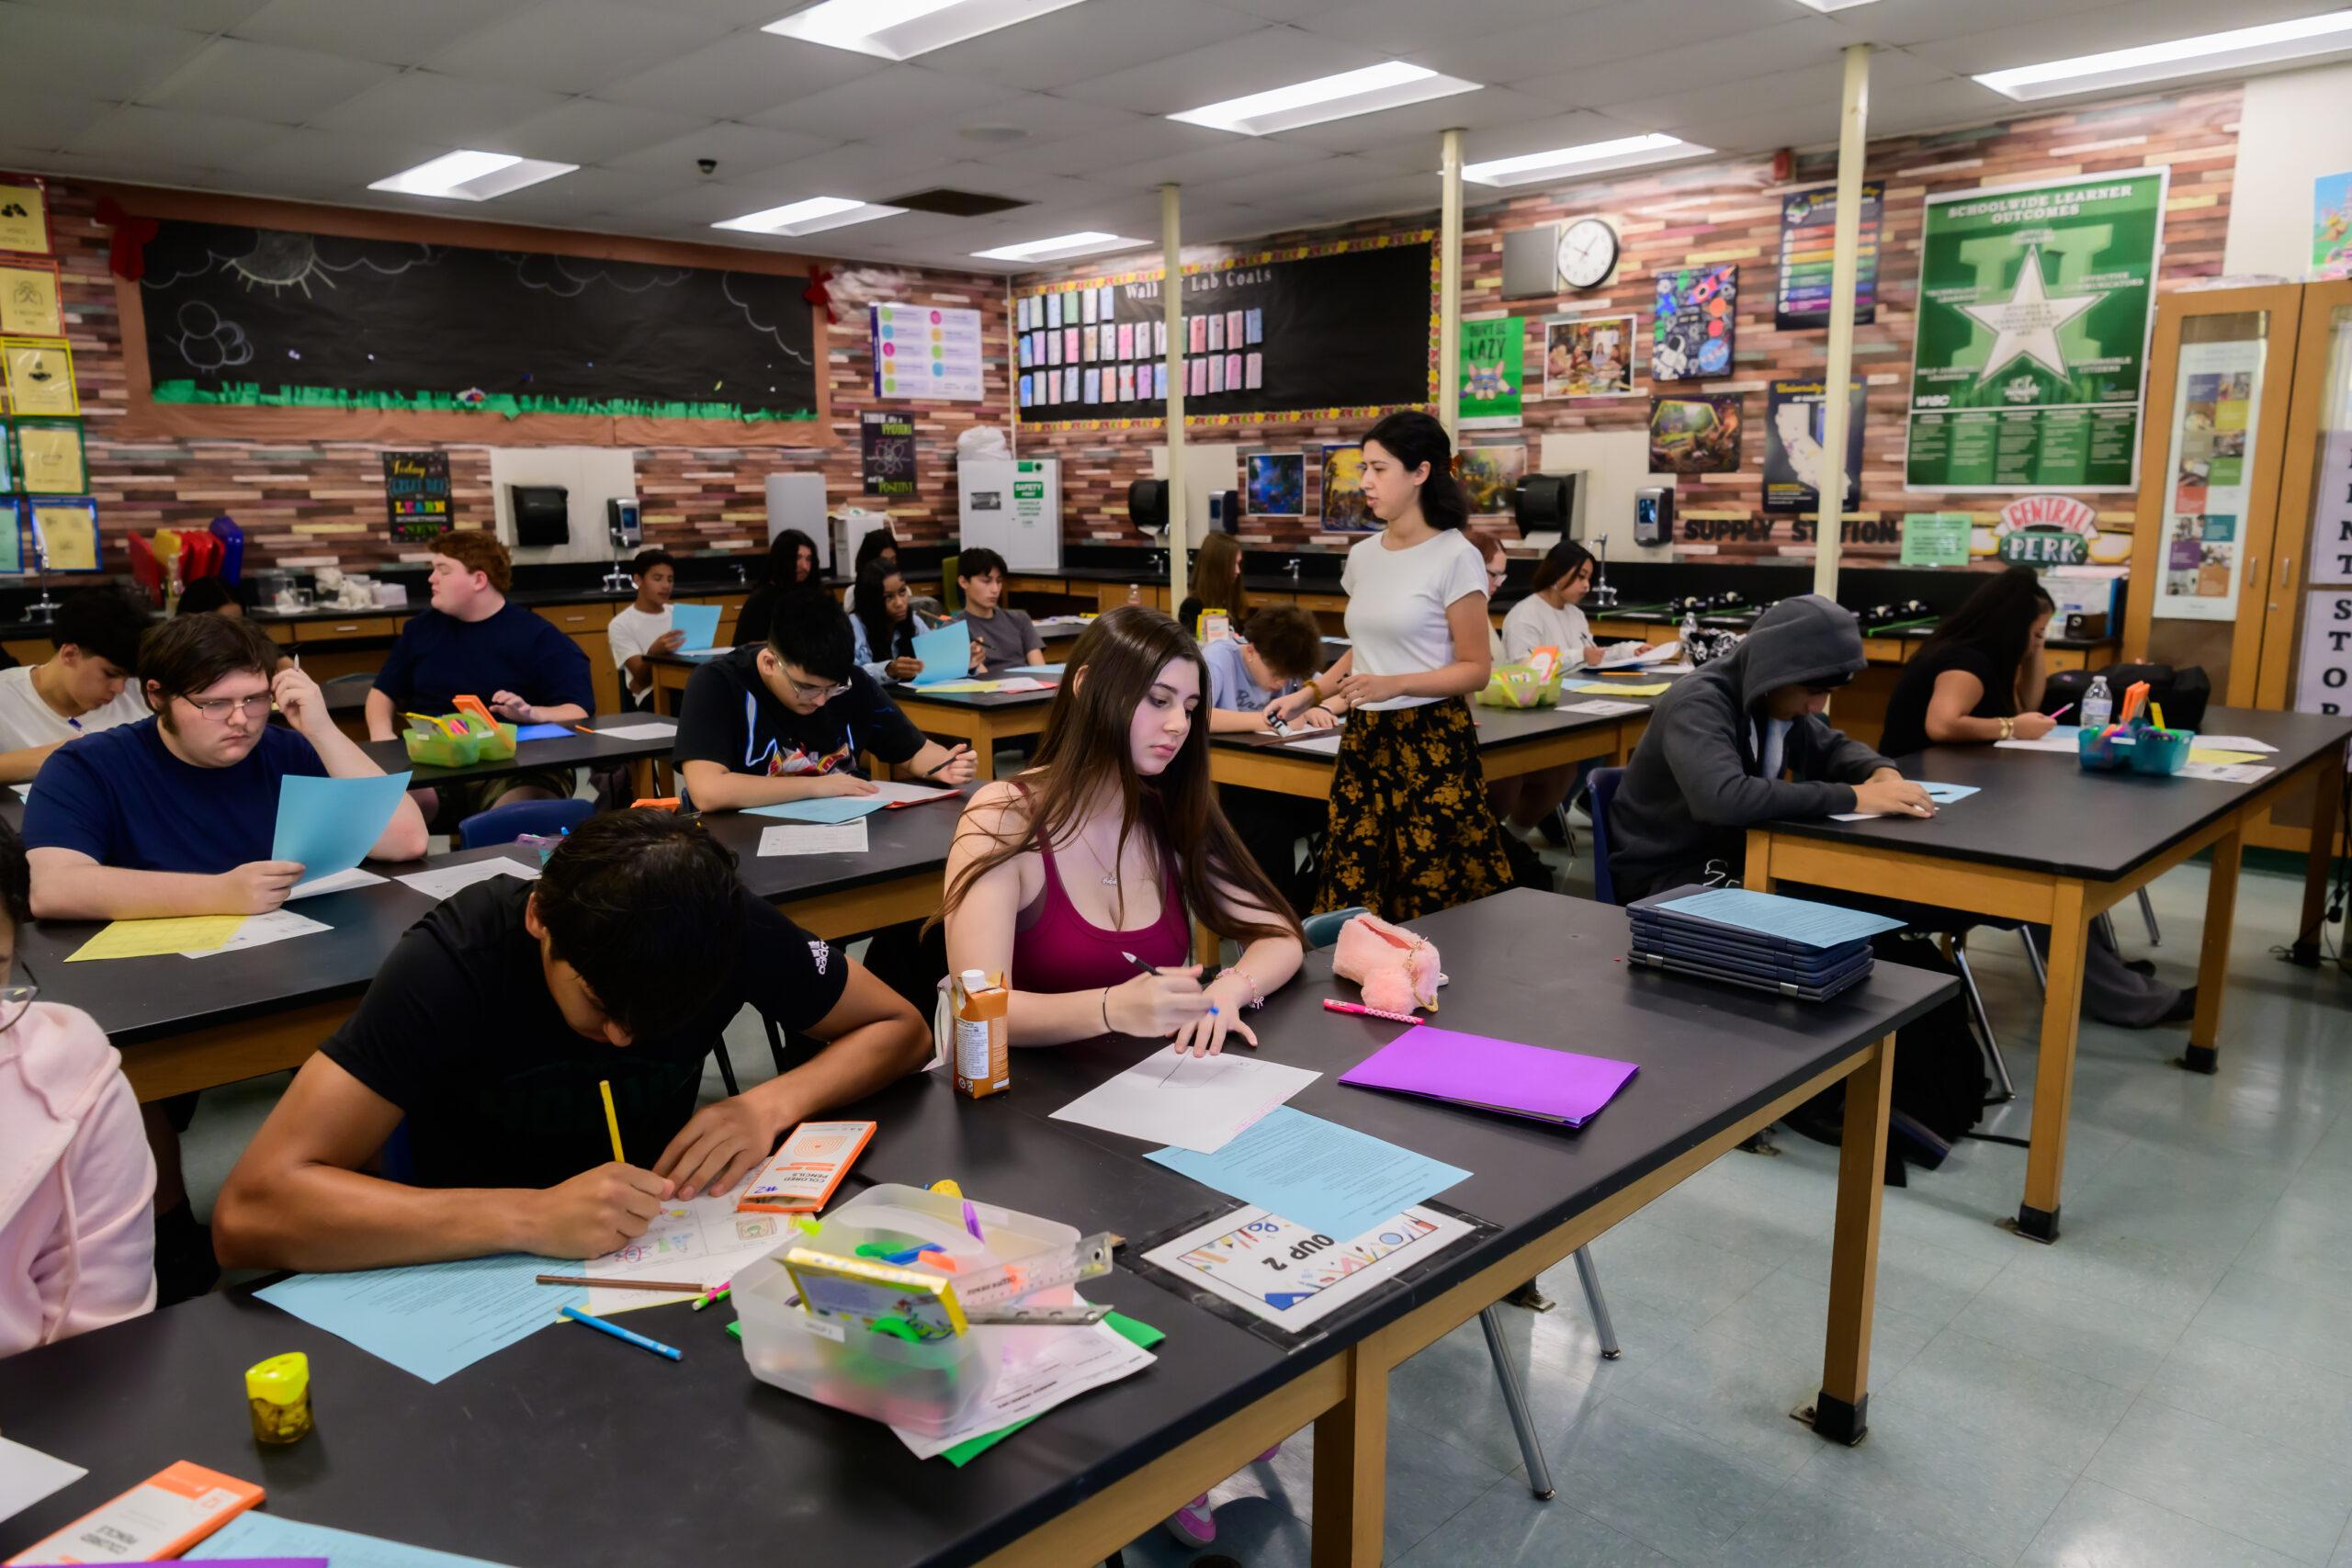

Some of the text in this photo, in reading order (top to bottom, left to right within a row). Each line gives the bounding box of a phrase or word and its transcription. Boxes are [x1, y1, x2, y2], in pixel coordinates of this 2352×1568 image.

[1948, 185, 2132, 219] SCHOOLWIDE LEARNER
[1992, 205, 2080, 225] OUTCOMES
[1125, 268, 1272, 299] Wall Lab Coats
[1469, 337, 1506, 360] LAZY
[393, 460, 425, 479] Today
[878, 481, 913, 493] POSITIVE
[395, 501, 446, 513] LEARN
[2008, 498, 2089, 531] CENTRAL
[1684, 520, 1774, 541] SUPPLY
[1792, 520, 1898, 543] STTION
[2009, 536, 2080, 561] PERK
[753, 1185, 779, 1194] #2
[1261, 1234, 1335, 1271] OUP 2
